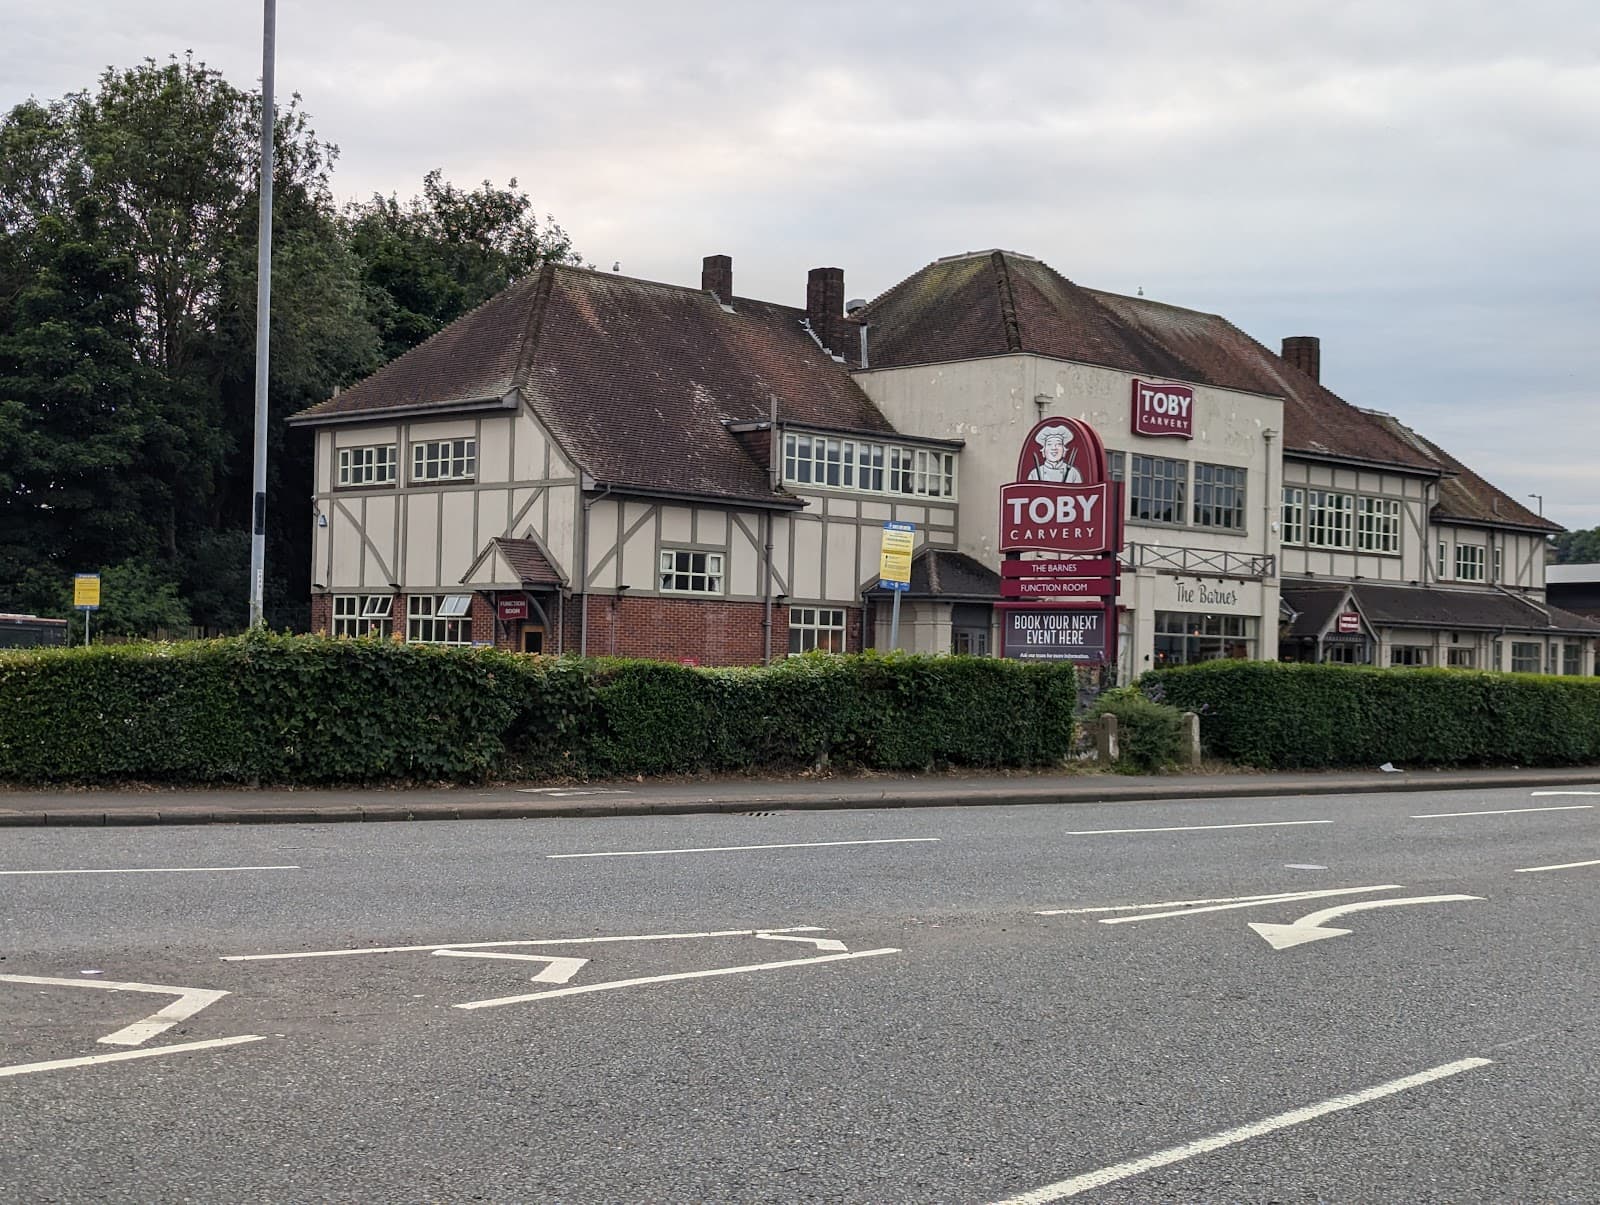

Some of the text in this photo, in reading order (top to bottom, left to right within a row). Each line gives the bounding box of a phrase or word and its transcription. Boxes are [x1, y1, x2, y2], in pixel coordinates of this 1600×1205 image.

[1141, 390, 1191, 417] TOBY
[1142, 415, 1188, 429] CARVERY
[1007, 494, 1099, 525] TOBY
[1010, 527, 1094, 541] CARVERY
[1032, 563, 1077, 572] THE BARNES
[1020, 583, 1088, 592] FUNCTION ROOM
[1176, 582, 1238, 605] The Barnes
[1014, 615, 1098, 630] BOOK YOUR NEXT
[1026, 630, 1084, 645] EVENT HERE
